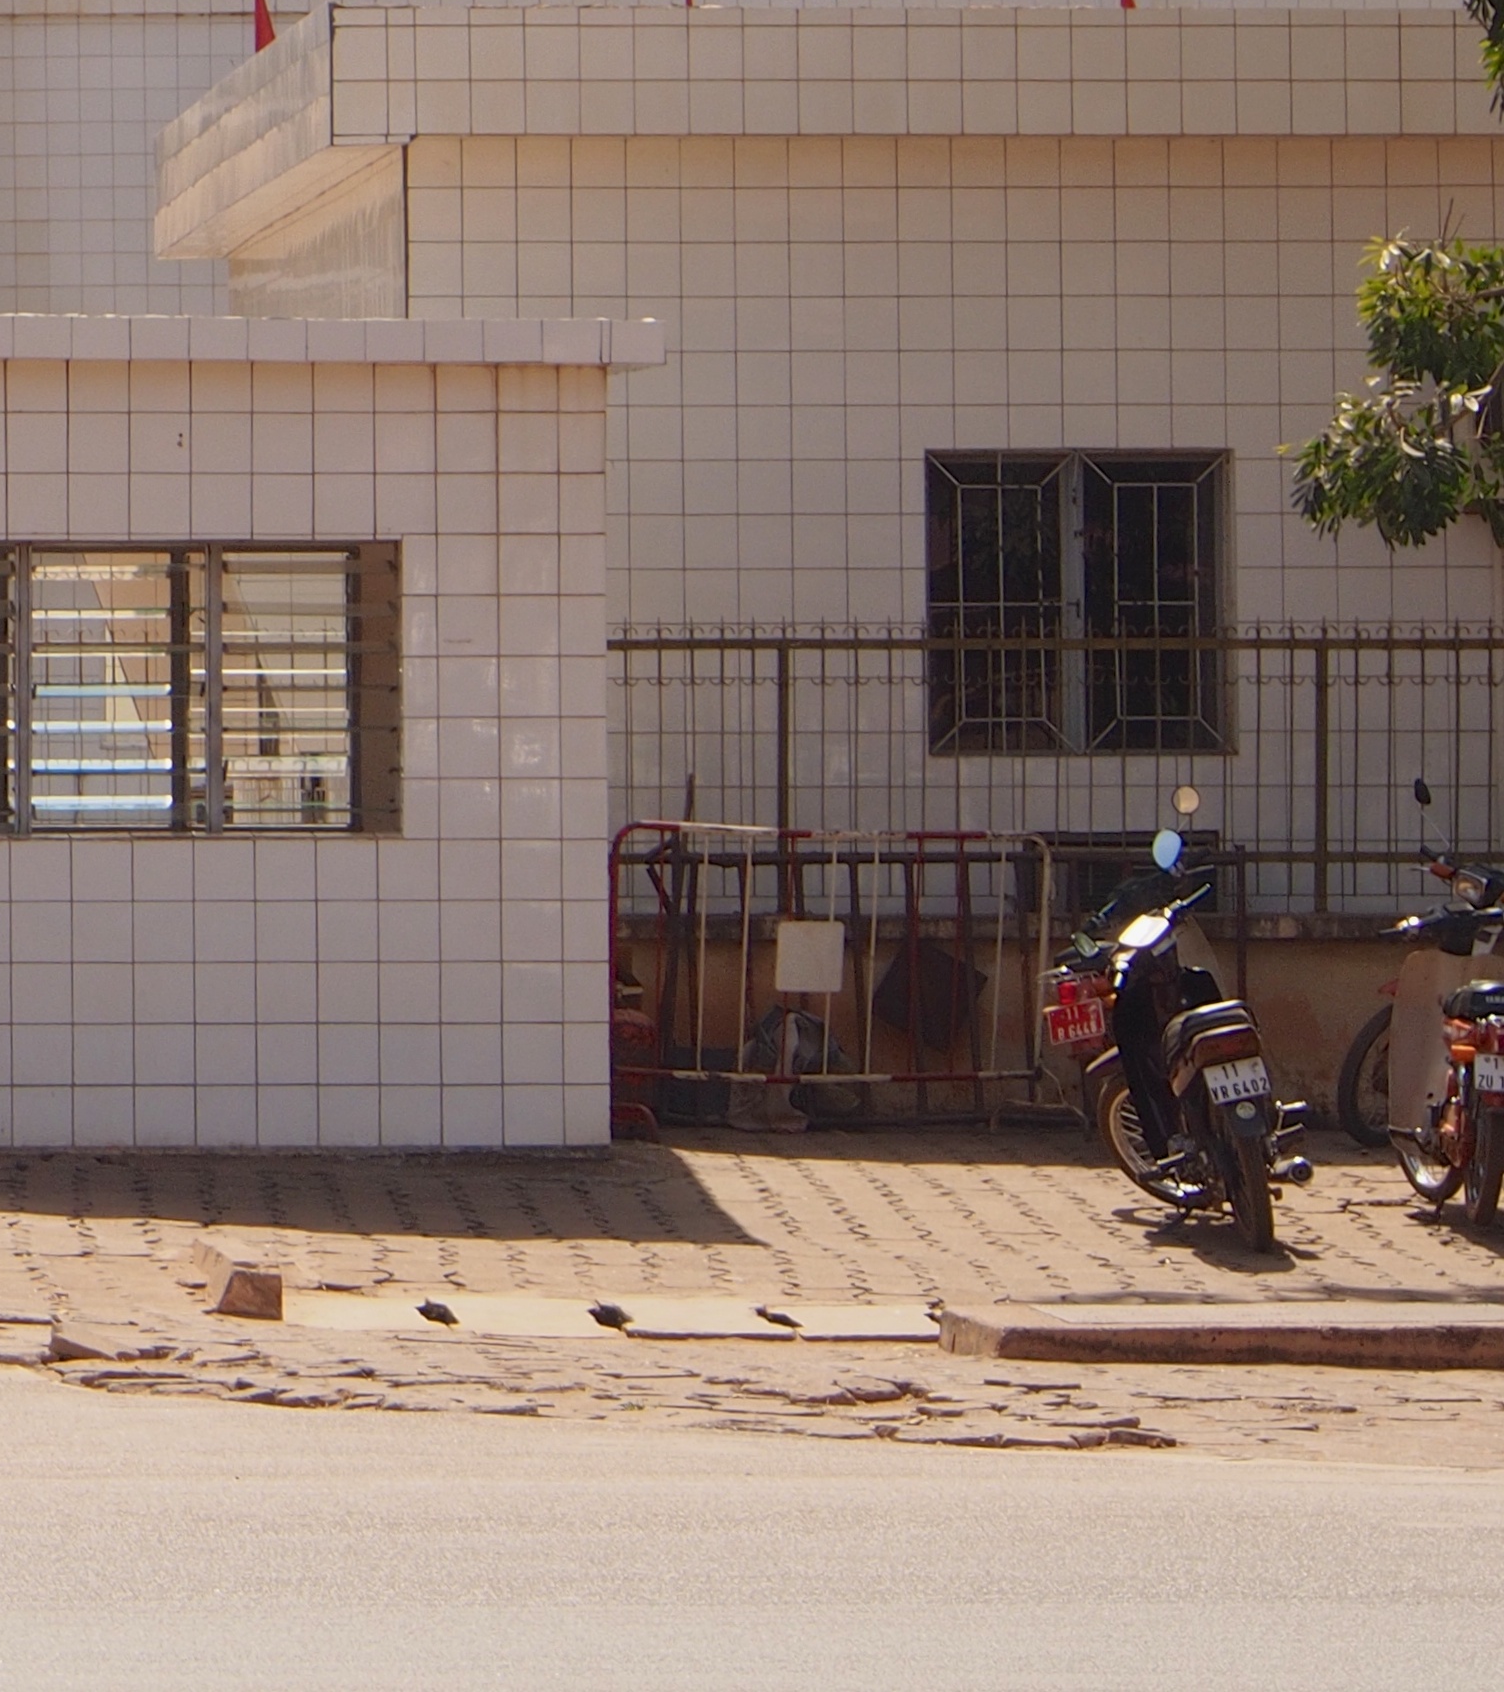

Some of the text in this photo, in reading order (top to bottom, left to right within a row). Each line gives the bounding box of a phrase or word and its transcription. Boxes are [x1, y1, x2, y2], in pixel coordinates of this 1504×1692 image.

[1066, 1006, 1079, 1020] 11
[1221, 1062, 1239, 1080] 11
[1232, 1076, 1267, 1097] 6402
[1478, 1074, 1493, 1089] ZU
